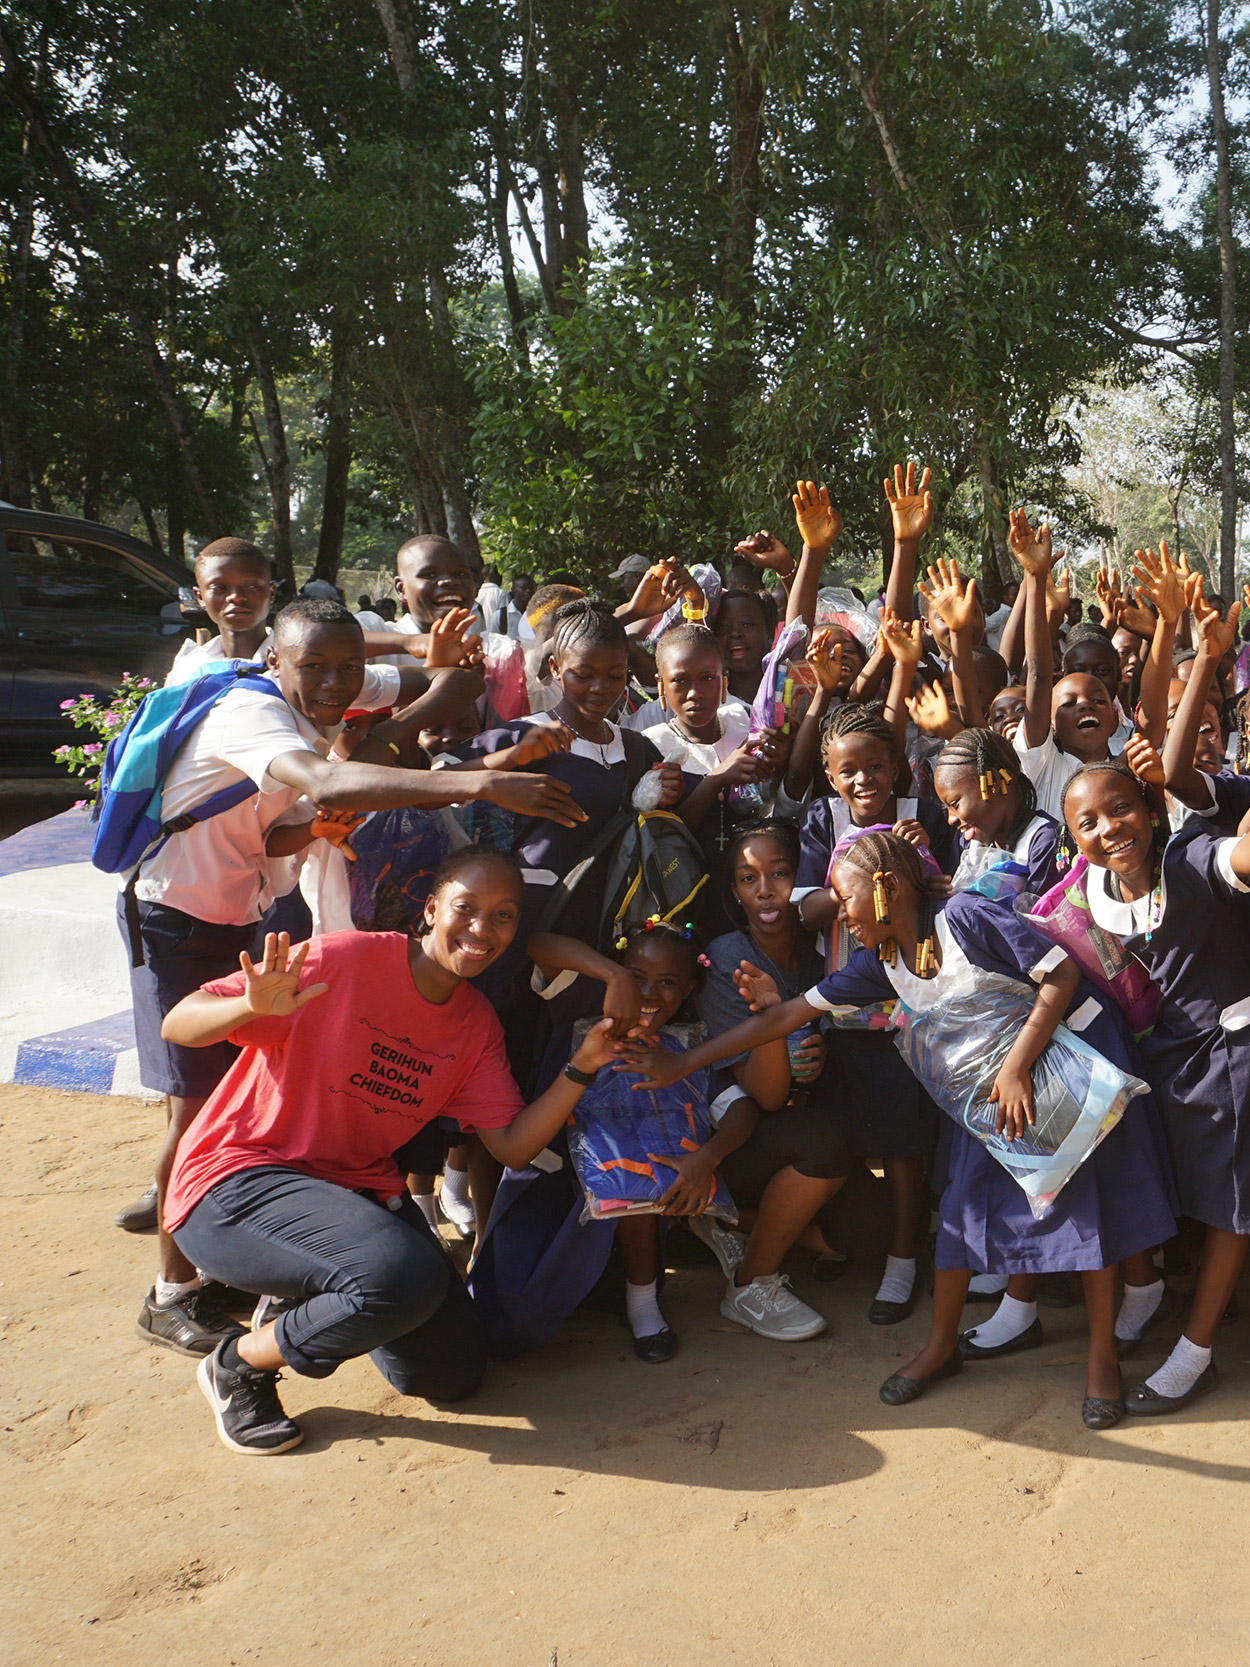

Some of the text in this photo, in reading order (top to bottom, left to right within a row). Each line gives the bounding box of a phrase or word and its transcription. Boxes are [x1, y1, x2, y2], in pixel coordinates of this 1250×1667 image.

[369, 1060, 419, 1090] BAOMA
[370, 1042, 433, 1076] GERIHUN
[349, 1073, 424, 1108] CHIEFDOM
